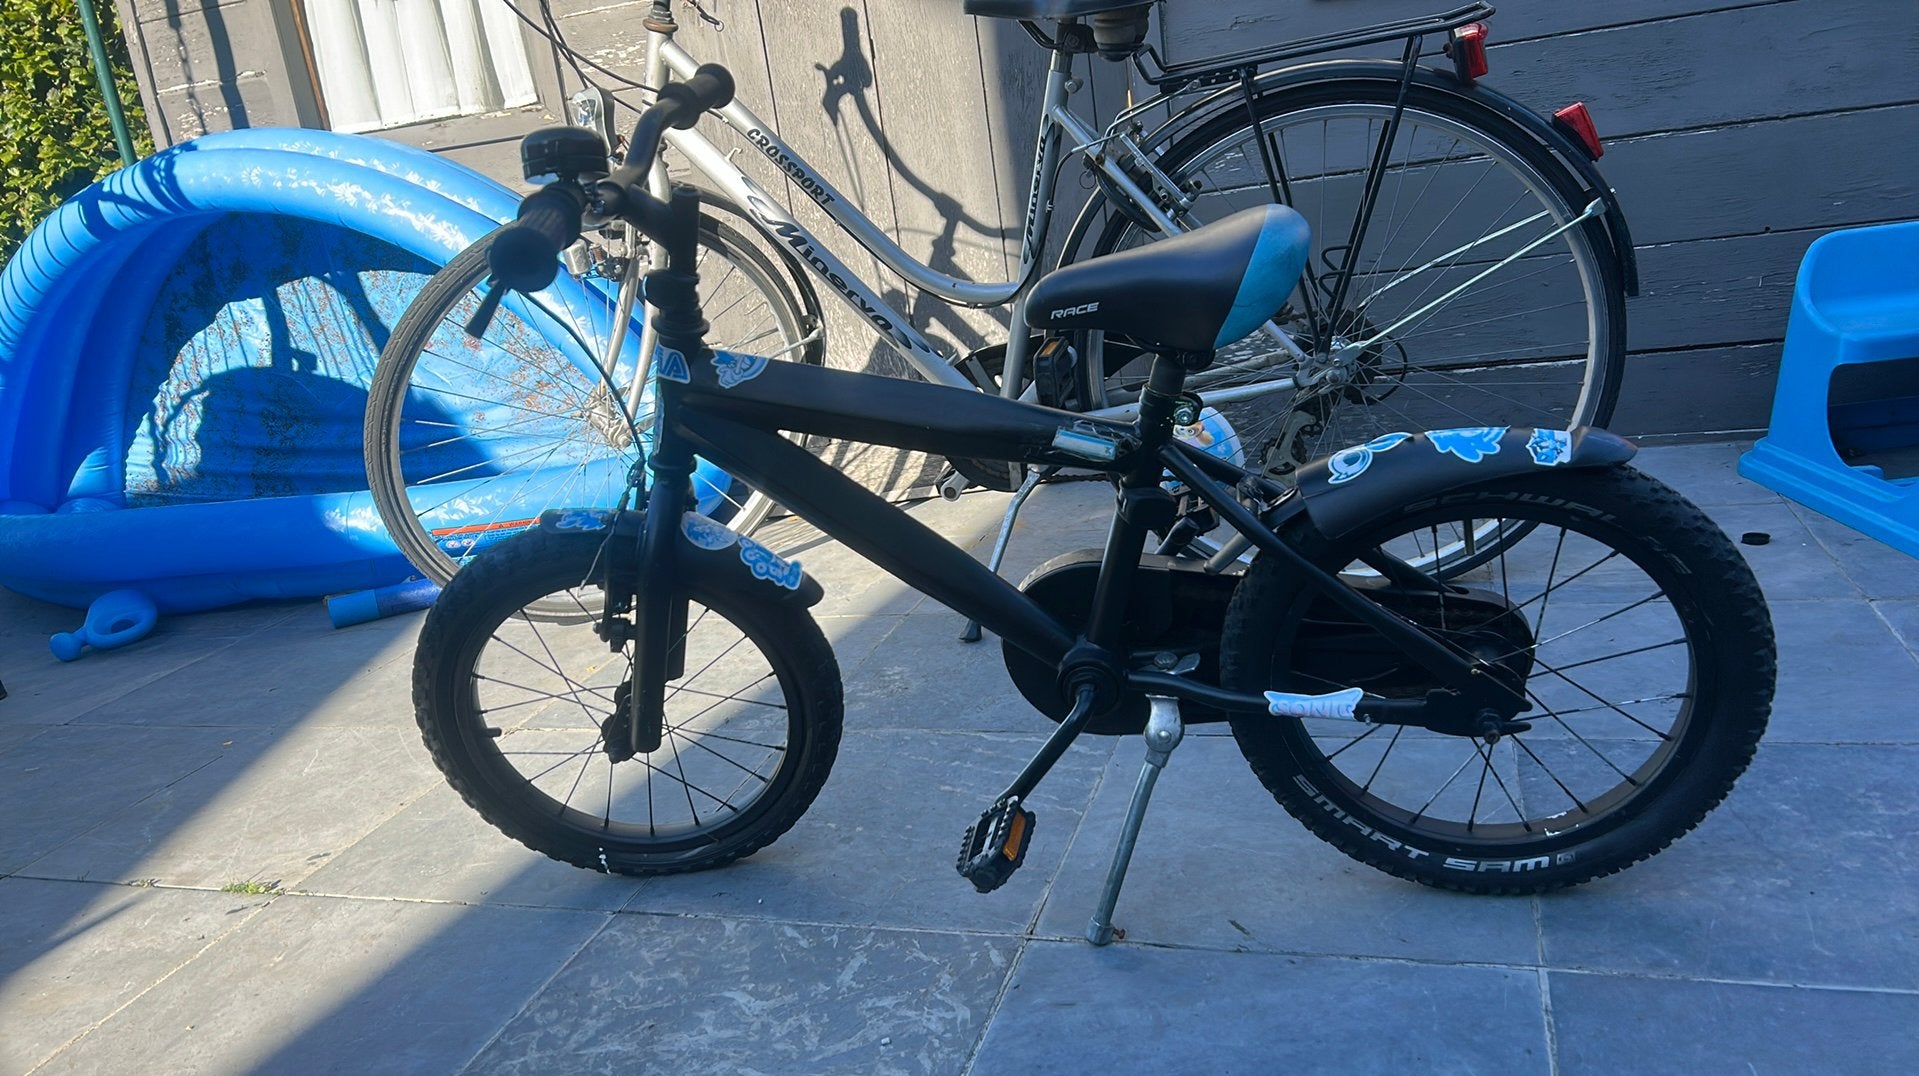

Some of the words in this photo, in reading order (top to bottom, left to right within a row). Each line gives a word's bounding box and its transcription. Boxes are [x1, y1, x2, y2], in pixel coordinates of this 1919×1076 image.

[747, 128, 836, 206] CROSSPORT
[750, 208, 893, 331] Minerva
[1050, 301, 1100, 320] RACE
[1271, 700, 1352, 717] SONIC
[1292, 774, 1430, 861] SMART
[1442, 855, 1550, 873] SAM
